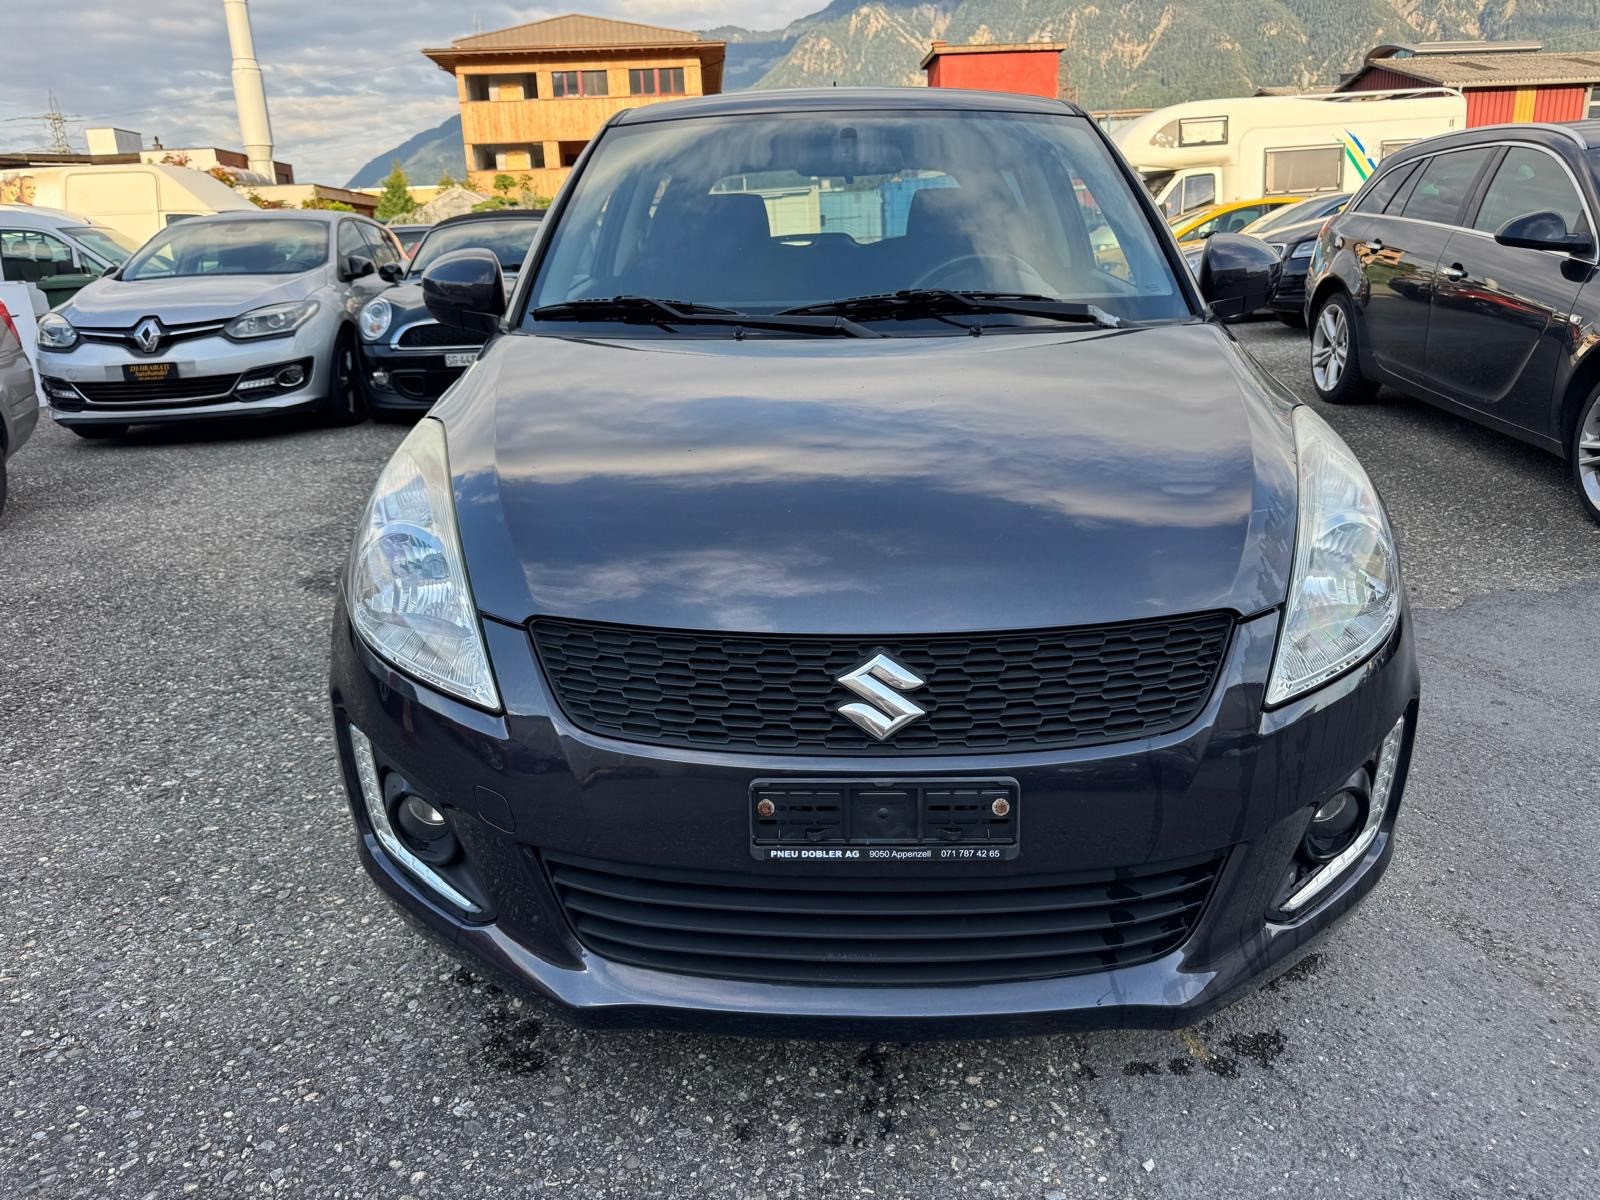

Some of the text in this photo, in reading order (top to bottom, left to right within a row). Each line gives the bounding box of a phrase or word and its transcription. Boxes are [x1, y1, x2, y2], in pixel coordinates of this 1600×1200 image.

[770, 849, 1000, 860] PNEU DOBLER AG 9050 Appenzell 071 787 42 65
